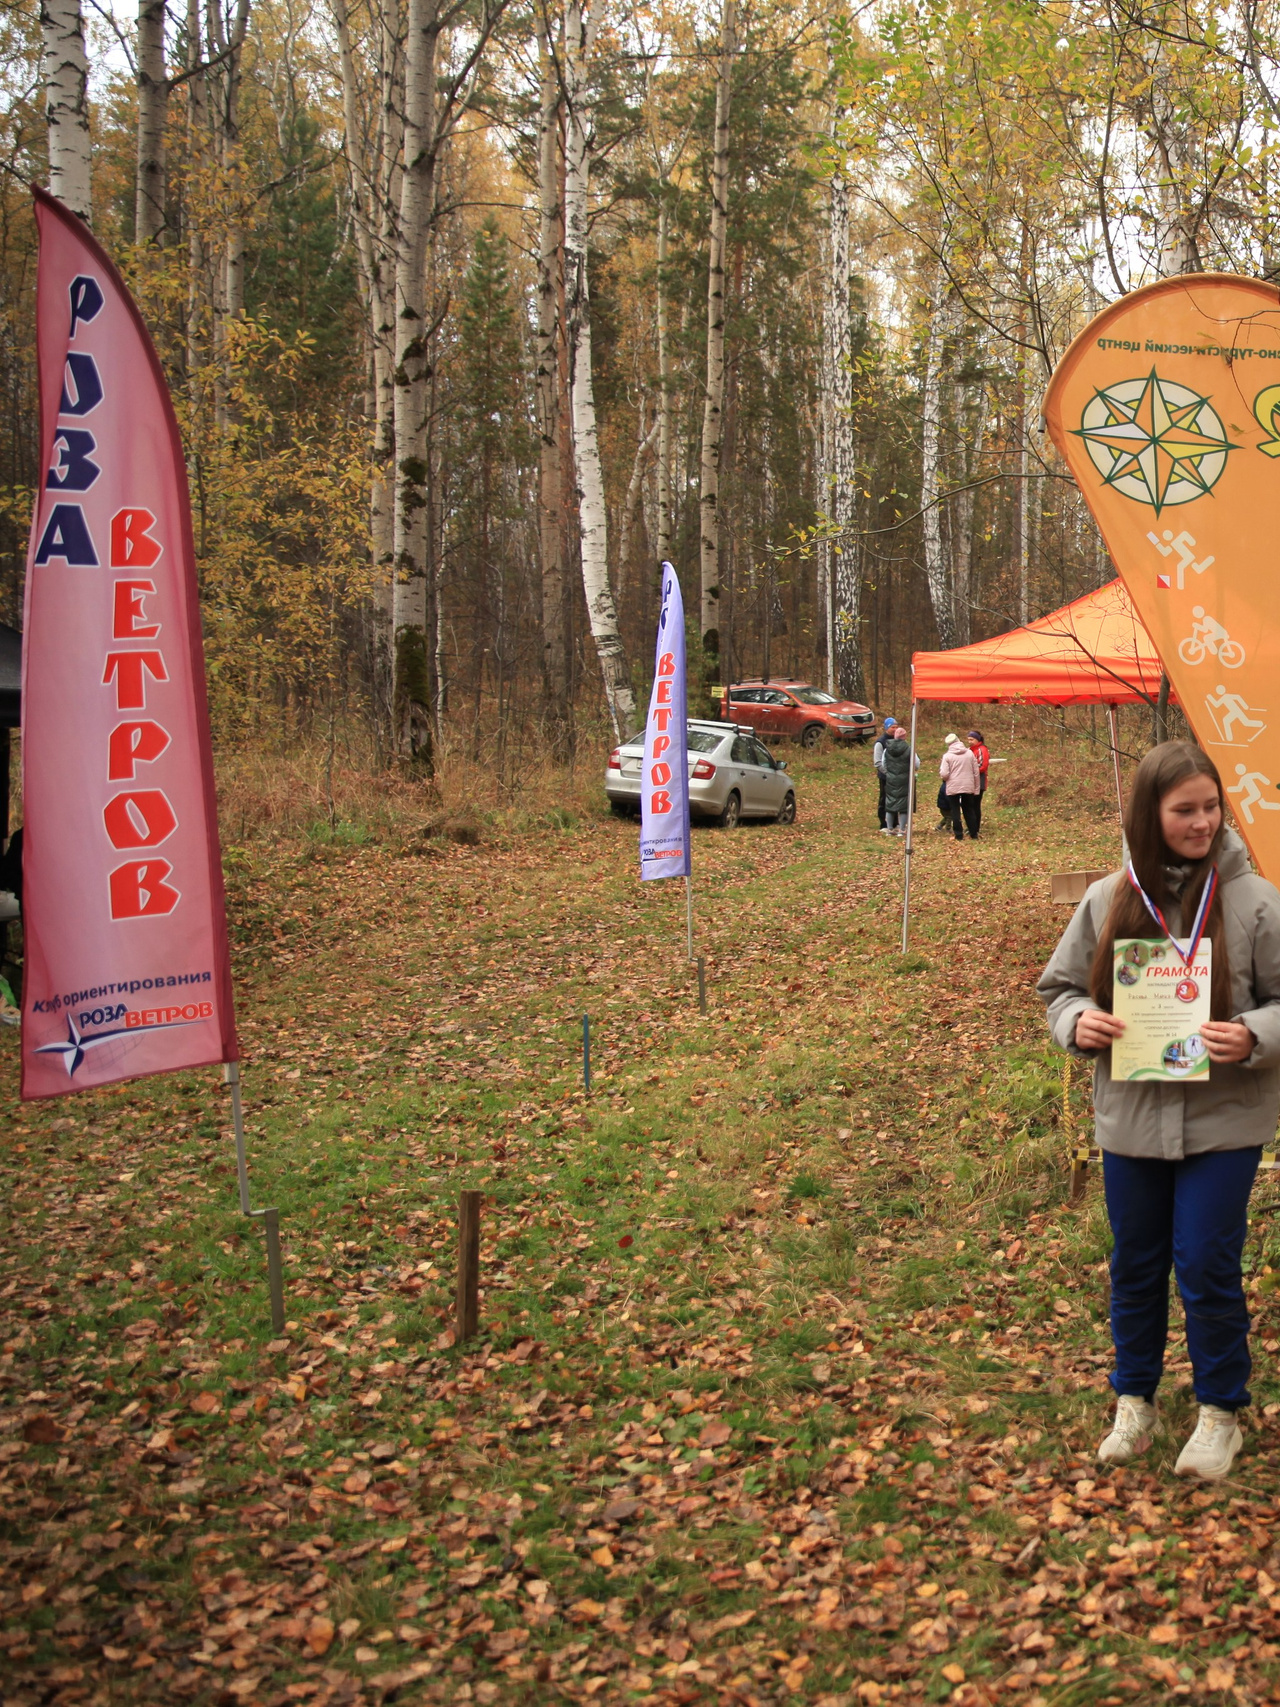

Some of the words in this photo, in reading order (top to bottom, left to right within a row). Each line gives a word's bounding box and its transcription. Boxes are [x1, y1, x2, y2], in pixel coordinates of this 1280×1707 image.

[34, 273, 105, 567] РОЗА
[102, 507, 183, 922] ВЕТРОВ
[651, 652, 675, 815] ВЕТРОВ
[32, 993, 61, 1013] Клуб
[63, 971, 212, 1007] ориентирования
[1146, 966, 1208, 977] ГРАМОТА
[1180, 985, 1188, 995] 3
[79, 1003, 128, 1029] РОЗА
[124, 1001, 214, 1028] ВЕТРОВ
